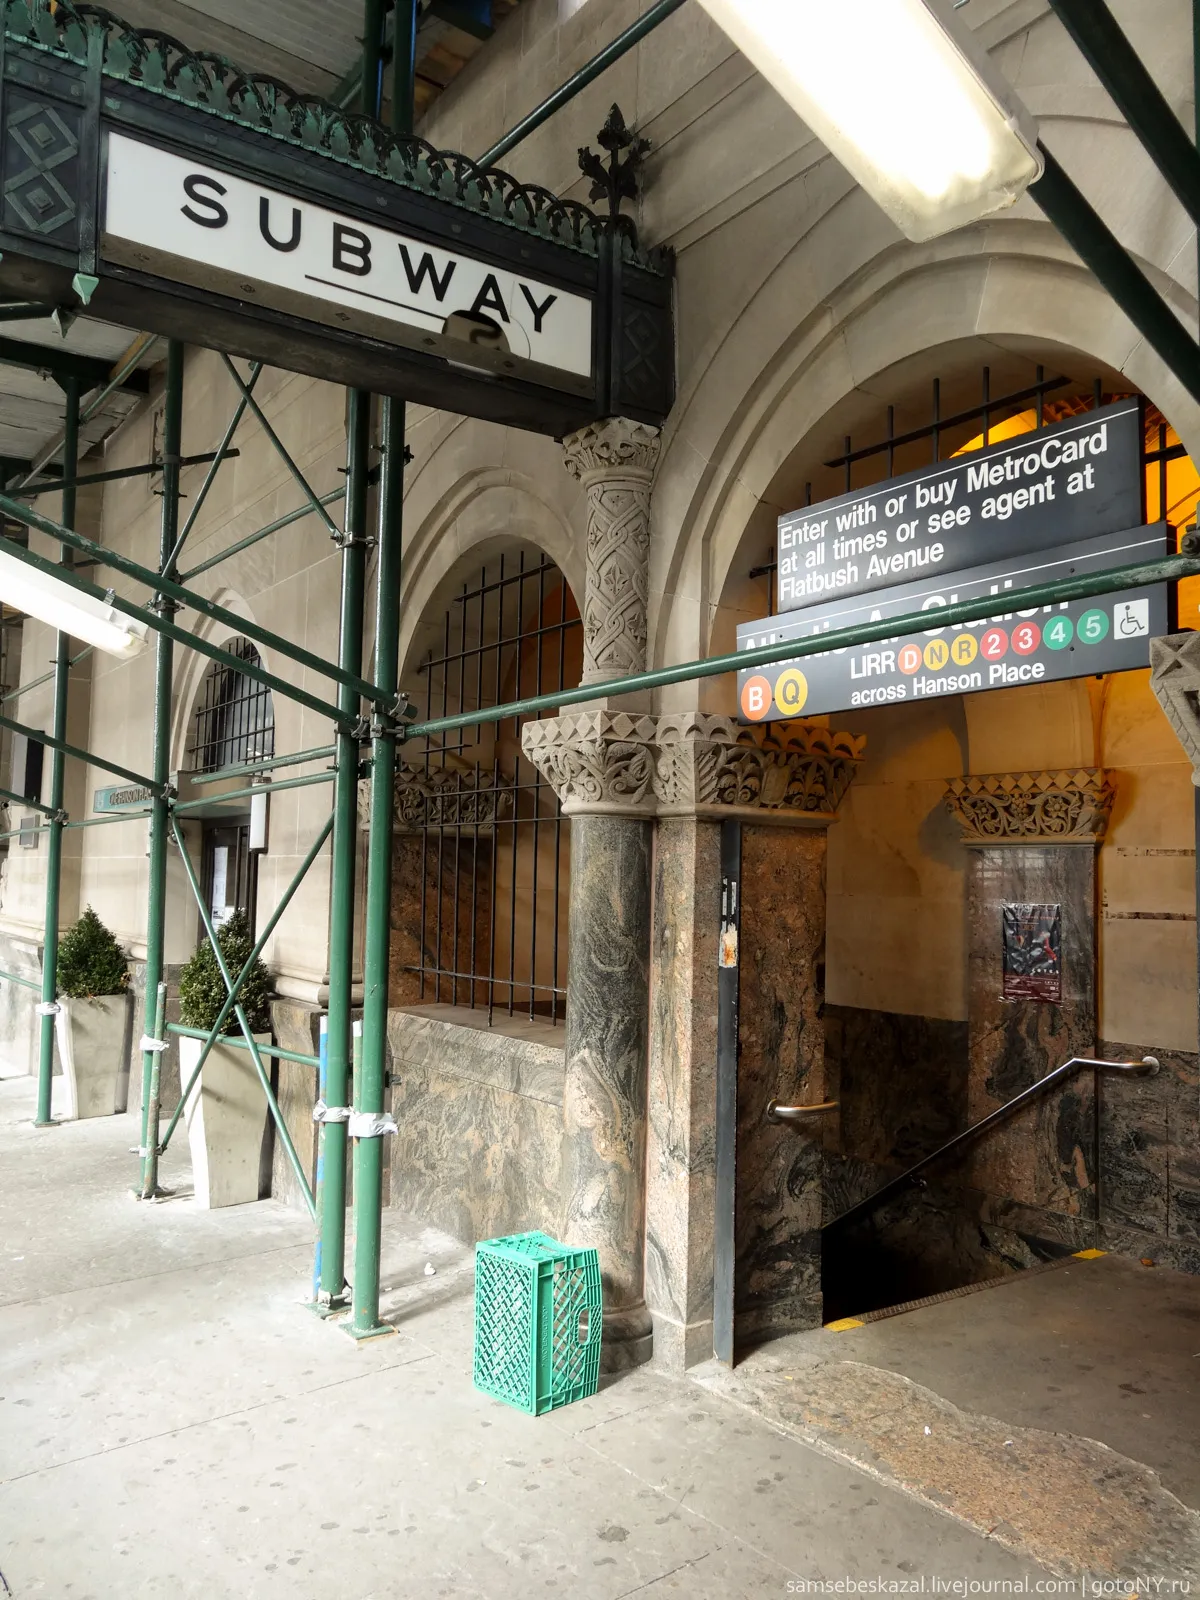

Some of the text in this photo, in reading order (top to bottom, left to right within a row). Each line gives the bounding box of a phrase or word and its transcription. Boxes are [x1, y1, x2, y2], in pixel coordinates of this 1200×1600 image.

[180, 173, 558, 333] SUBWAY
[780, 424, 1107, 550] Enter with or buy MetroCard
[781, 463, 1095, 575] at all times or see agent at
[780, 542, 944, 601] Flatbush Avenue
[850, 615, 1101, 680] LIRR D N R 2 3 4 5
[749, 678, 800, 712] B Q
[851, 661, 1045, 706] across Hanson Place
